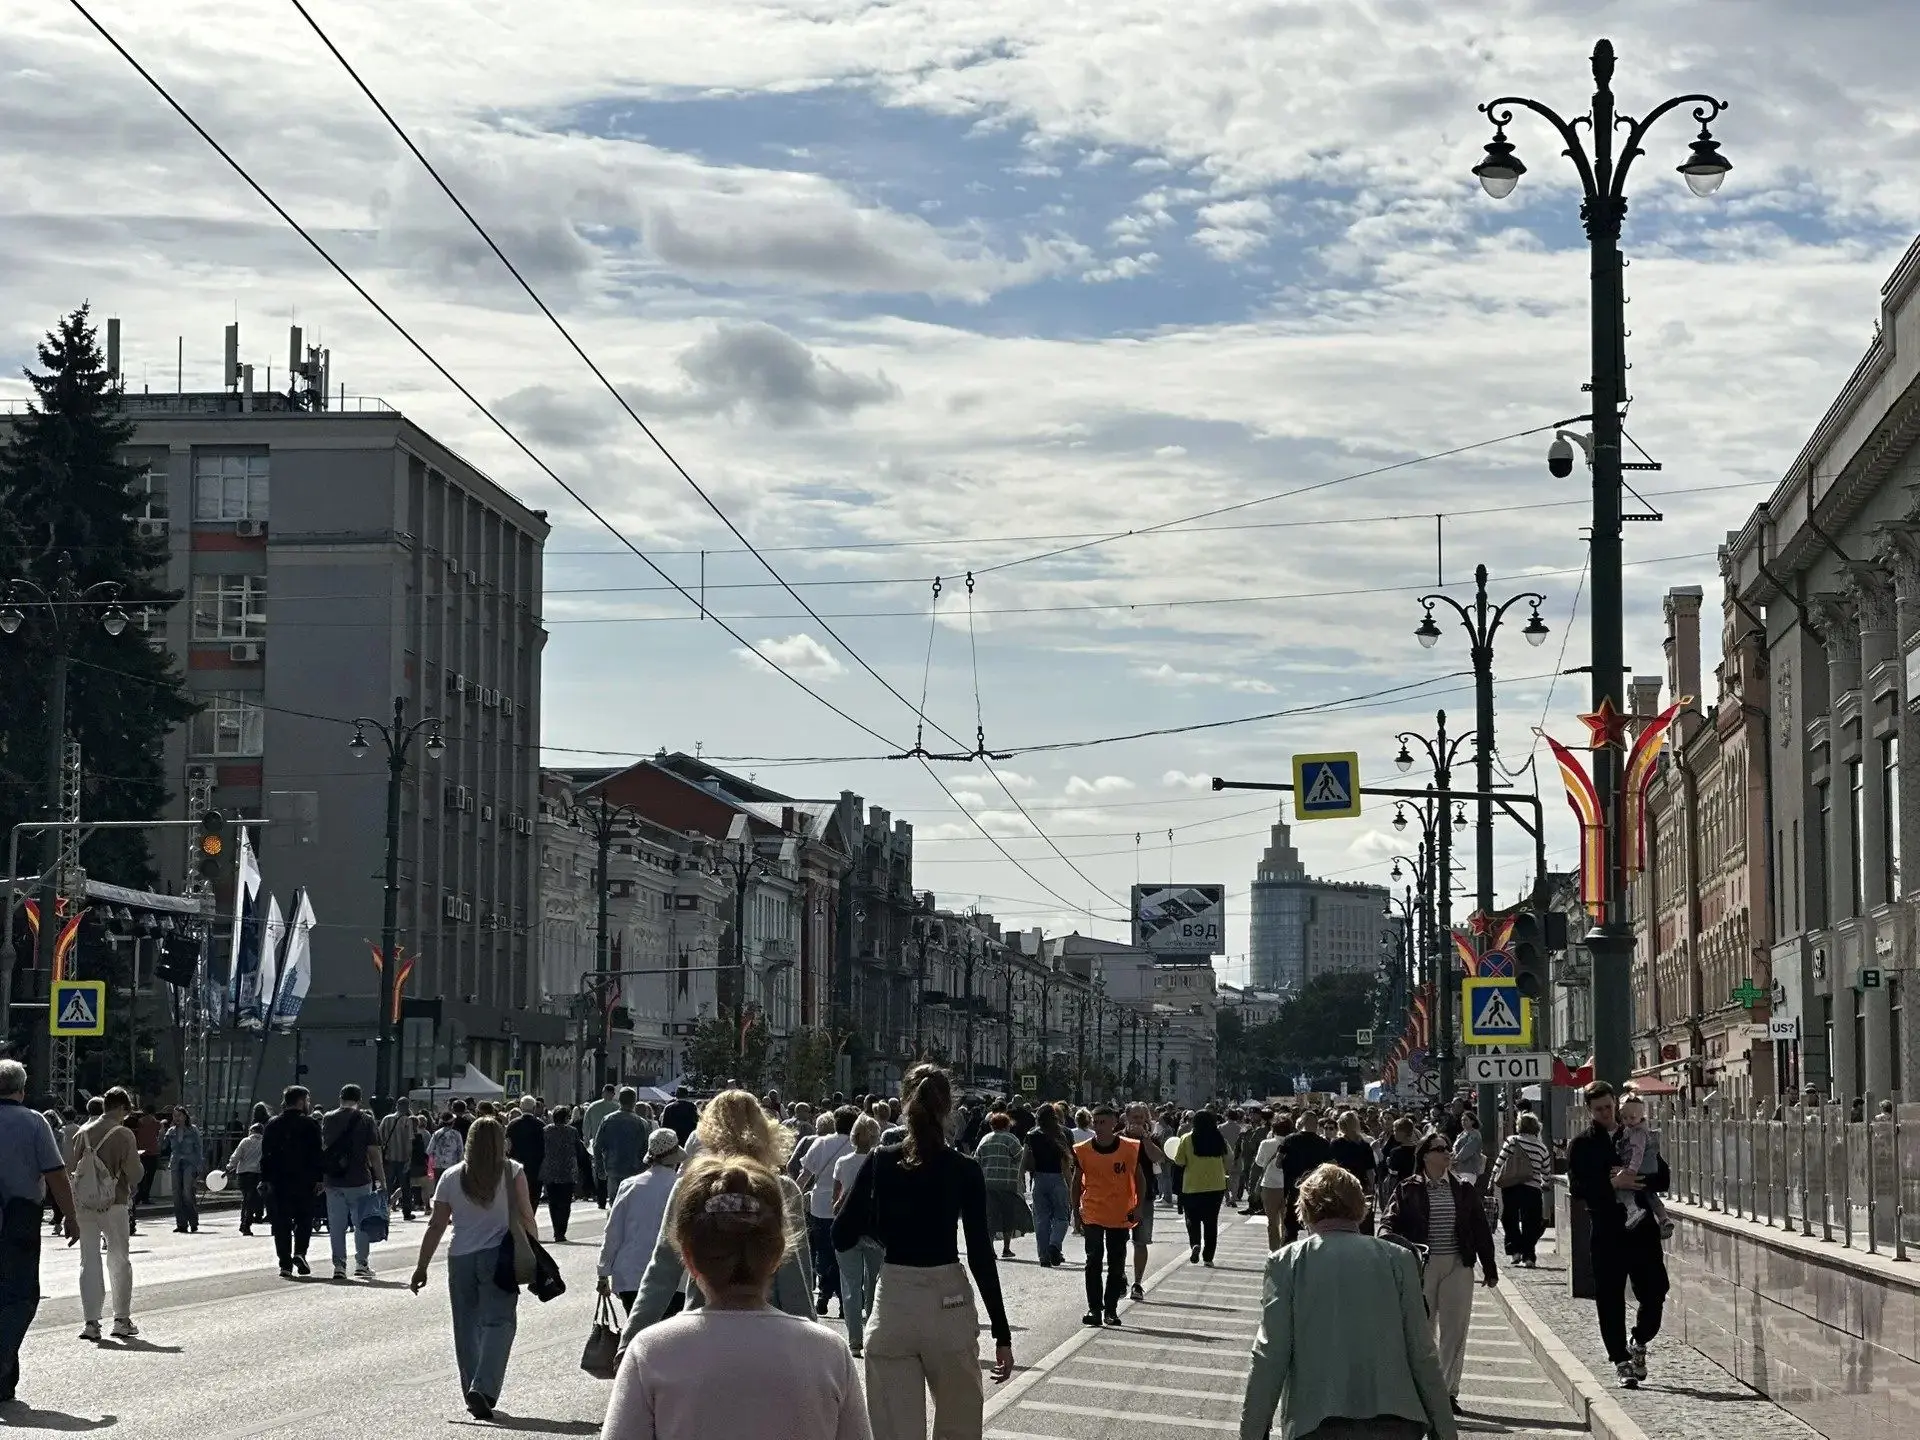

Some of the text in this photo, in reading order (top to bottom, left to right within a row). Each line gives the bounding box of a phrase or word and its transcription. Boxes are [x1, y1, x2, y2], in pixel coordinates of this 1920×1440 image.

[1183, 924, 1217, 940] ВЭД
[1772, 1023, 1794, 1033] US?
[1477, 1058, 1539, 1079] СТОП
